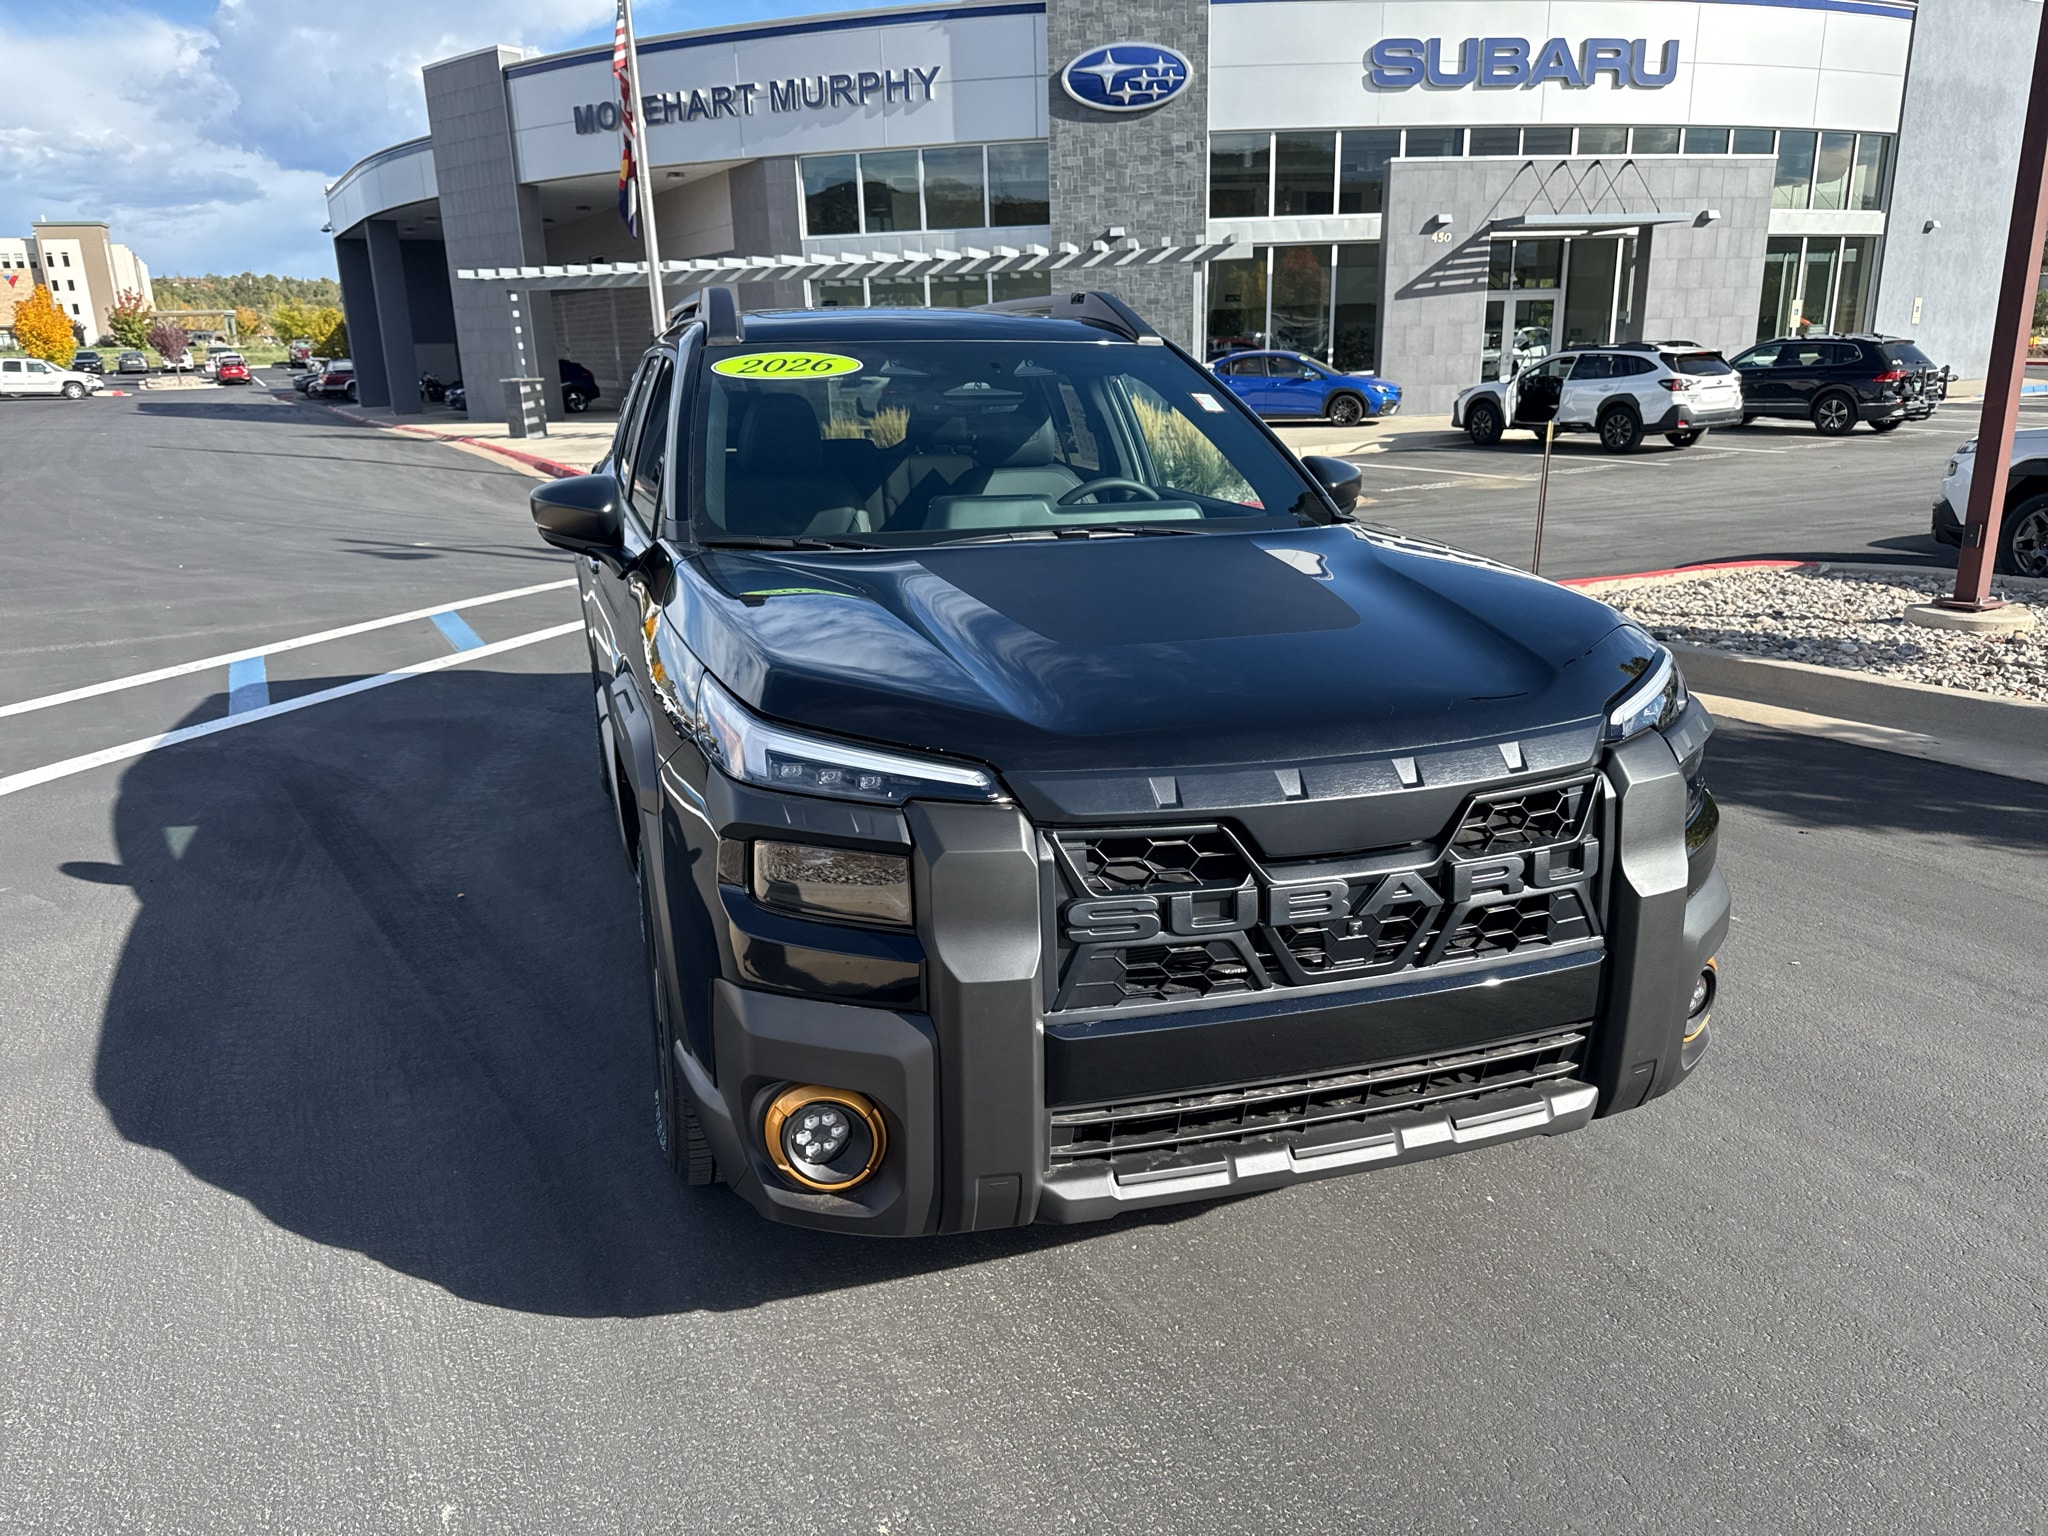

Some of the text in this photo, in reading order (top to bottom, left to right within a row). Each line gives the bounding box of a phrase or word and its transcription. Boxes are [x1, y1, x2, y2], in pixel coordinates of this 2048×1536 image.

[1364, 37, 1680, 91] SUBARU
[574, 65, 942, 135] MOEHART MURPHY
[1431, 231, 1452, 243] 450
[736, 358, 837, 374] 2026
[1064, 836, 1601, 943] SUBARU
